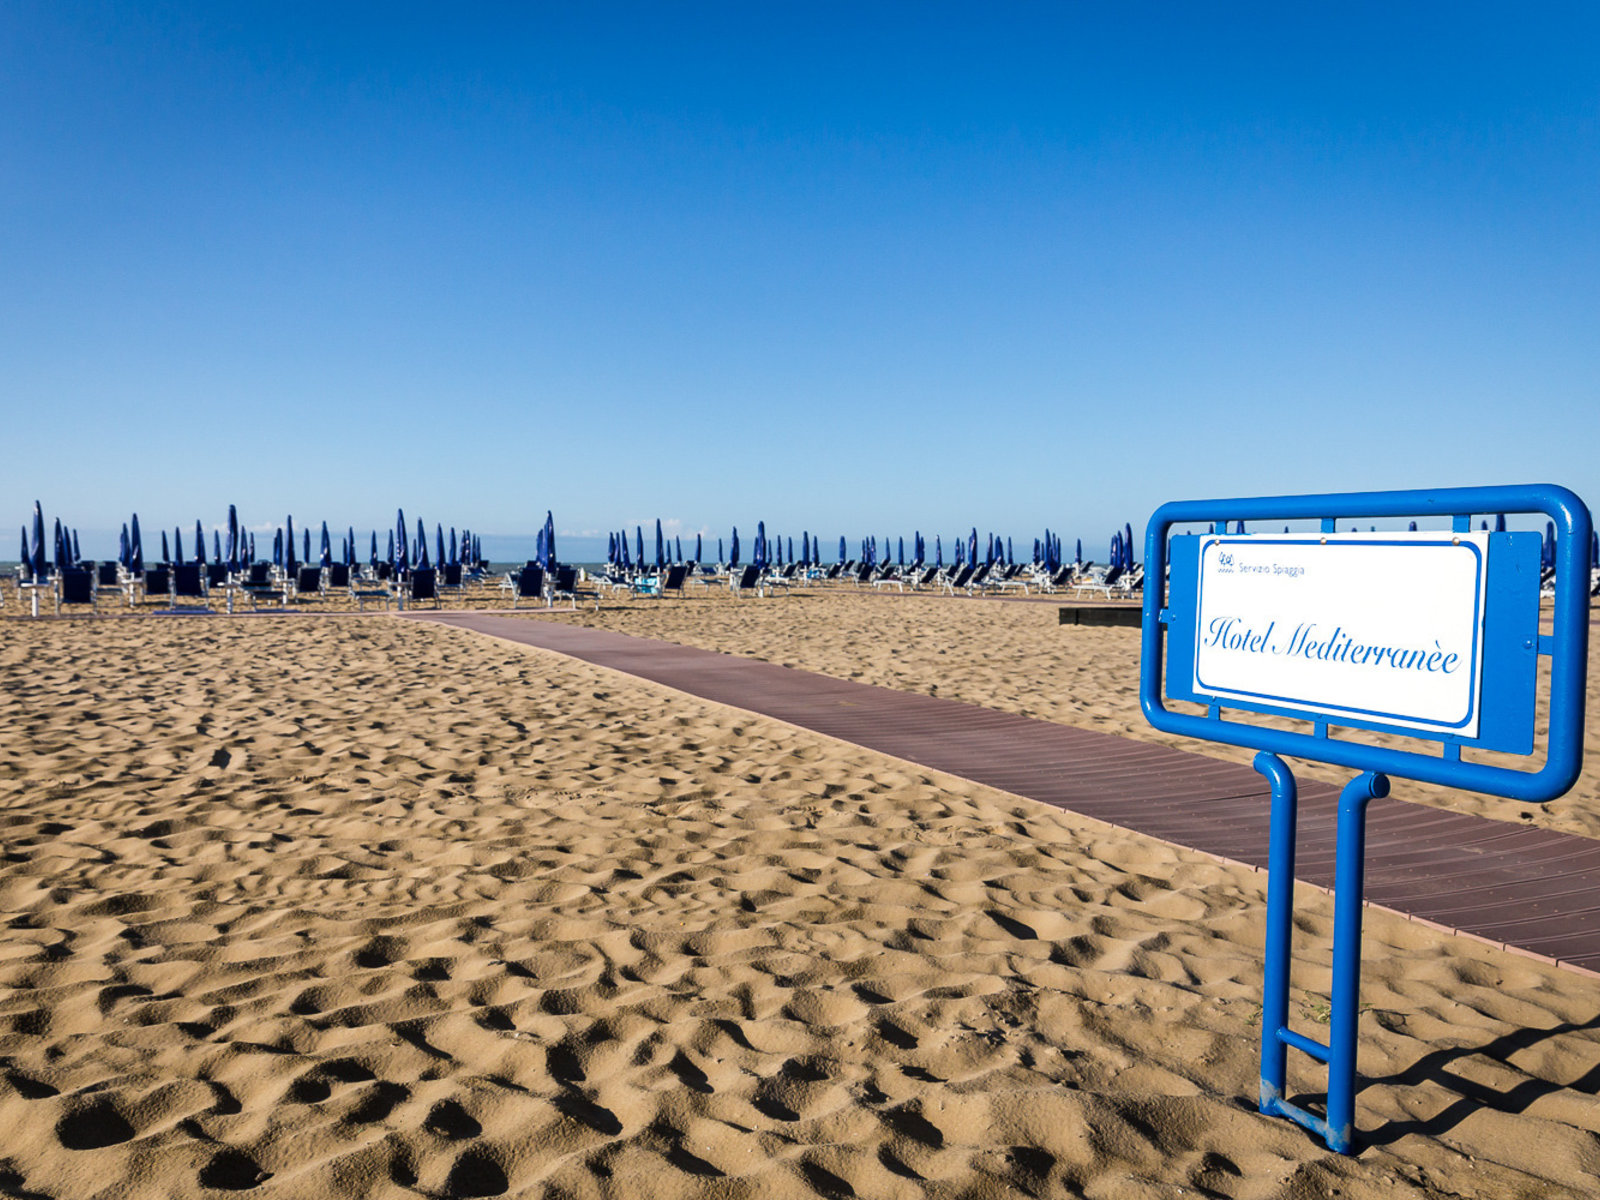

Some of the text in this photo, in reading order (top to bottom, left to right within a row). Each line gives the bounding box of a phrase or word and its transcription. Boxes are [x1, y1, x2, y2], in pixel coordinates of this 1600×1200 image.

[1239, 562, 1305, 578] Servizio Spiaggia
[1204, 616, 1462, 674] Hotel Mediterranèe
